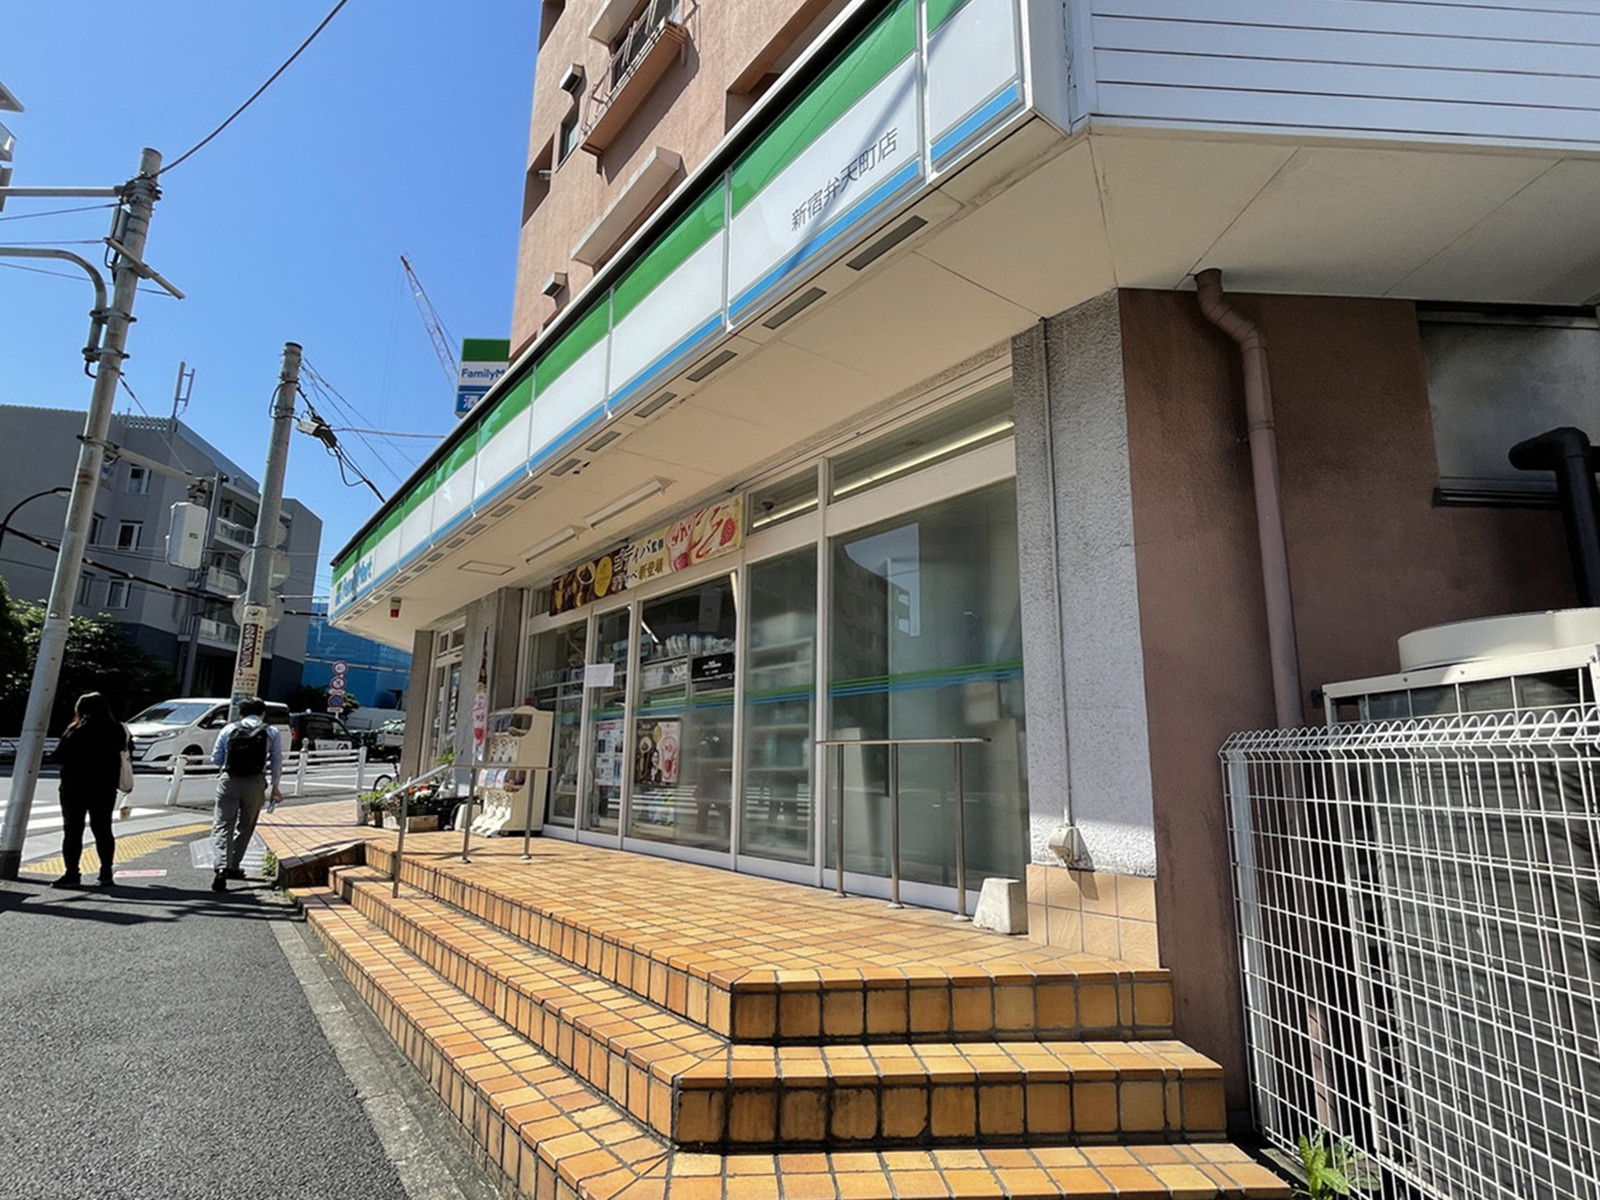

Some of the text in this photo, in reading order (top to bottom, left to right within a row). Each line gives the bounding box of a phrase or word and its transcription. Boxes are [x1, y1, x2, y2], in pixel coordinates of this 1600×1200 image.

[791, 127, 898, 231] 新宿弁天町店
